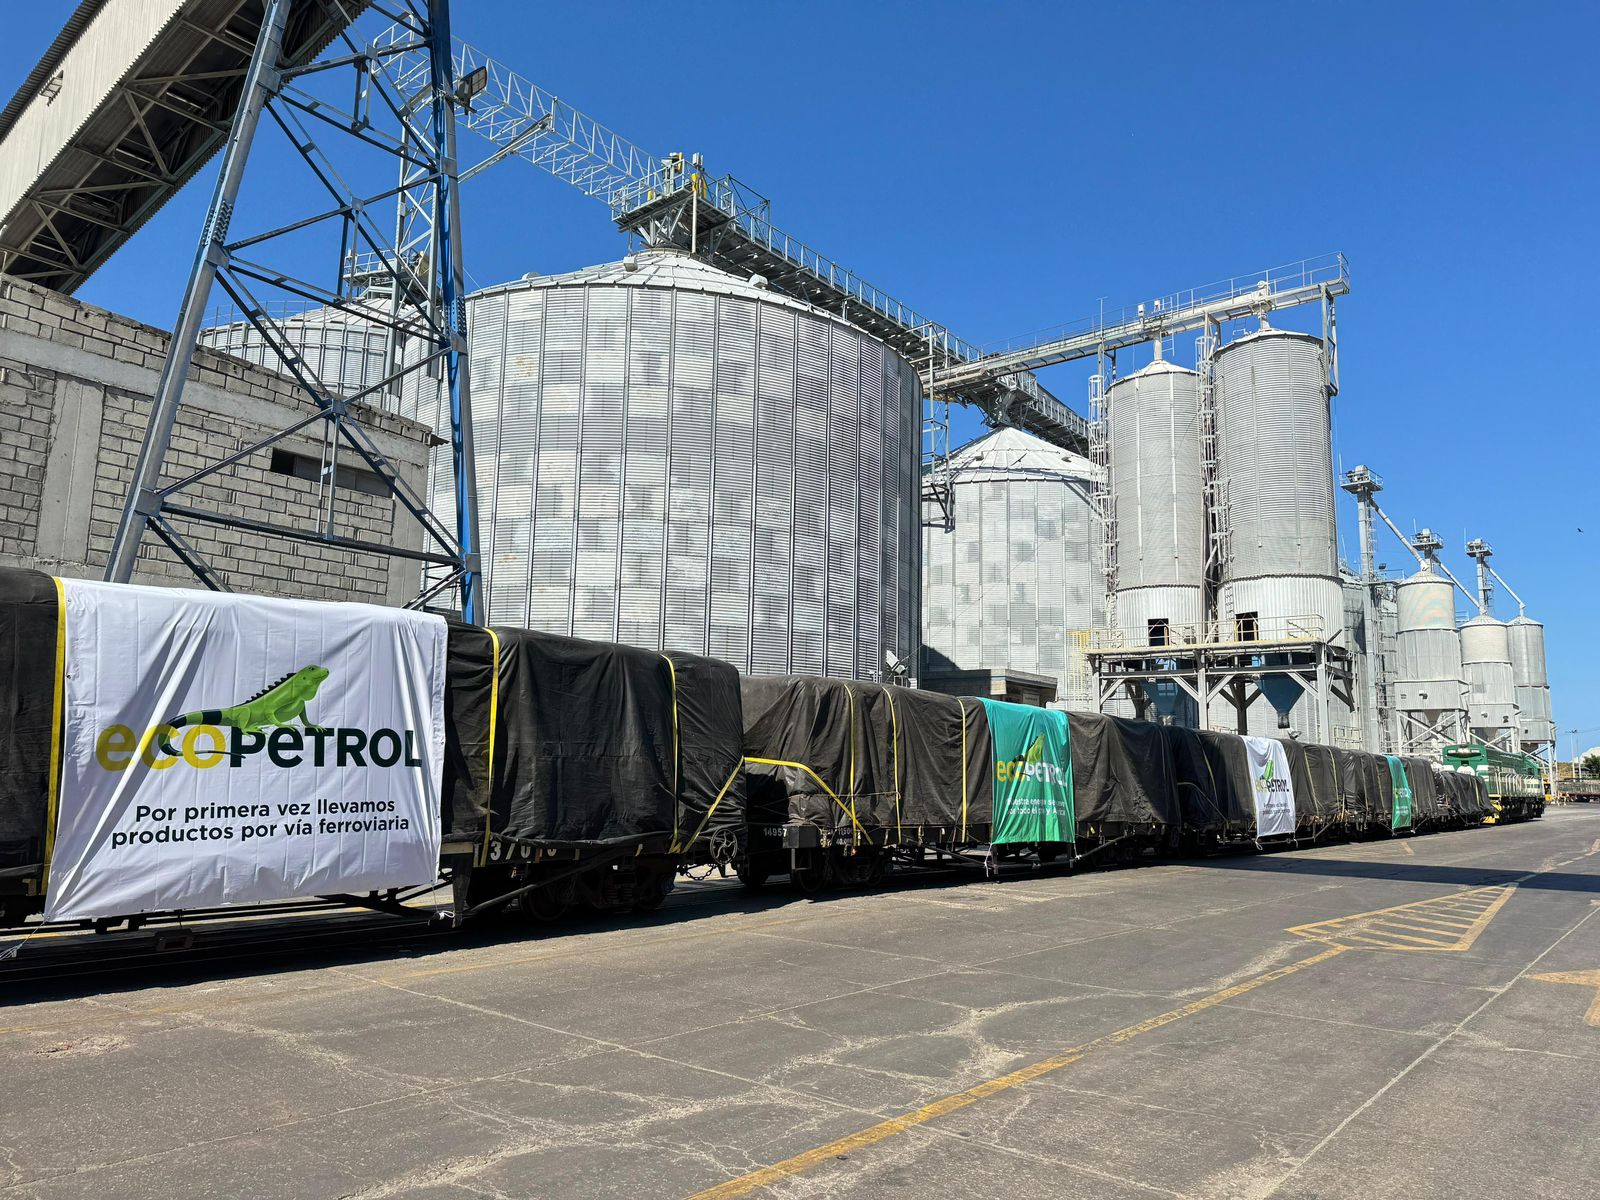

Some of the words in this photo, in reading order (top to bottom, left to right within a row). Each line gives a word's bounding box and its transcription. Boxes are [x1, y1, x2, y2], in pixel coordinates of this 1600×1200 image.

[135, 804, 177, 823] Por
[184, 801, 270, 823] primera
[276, 802, 311, 817] vez
[317, 798, 395, 816] llevamos
[111, 824, 233, 849] productos
[241, 822, 278, 841] por
[284, 818, 313, 836] vía
[319, 816, 410, 834] ferroviaria
[763, 827, 787, 837] 14957
